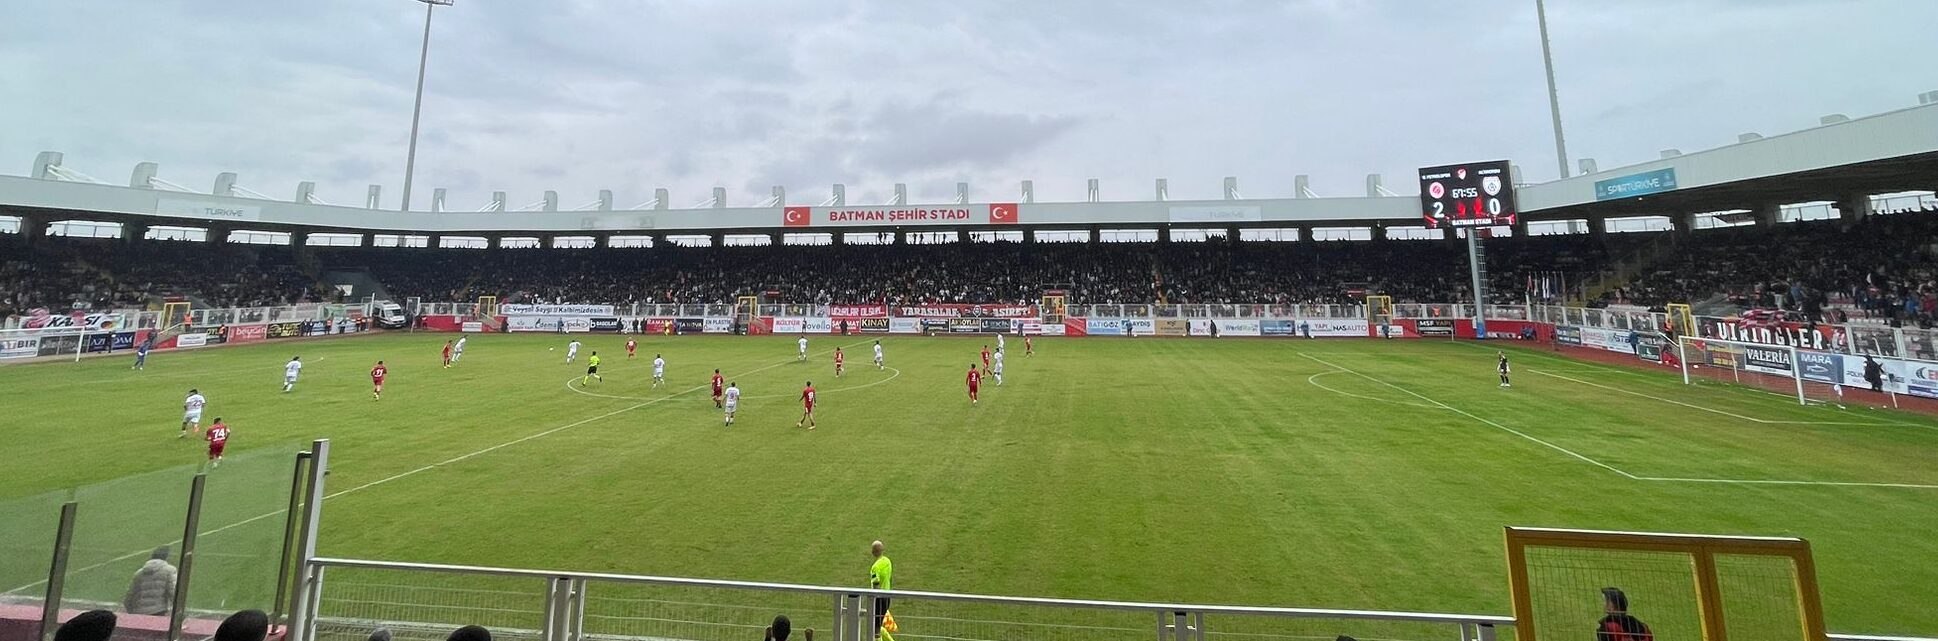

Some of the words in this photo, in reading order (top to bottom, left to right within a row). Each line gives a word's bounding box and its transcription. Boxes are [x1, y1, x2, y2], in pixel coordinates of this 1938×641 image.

[1452, 188, 1478, 199] 67:55
[1433, 202, 1445, 219] 2
[1489, 198, 1501, 215] 0
[829, 211, 885, 221] BATMAN
[888, 208, 927, 222] ŞEHİR
[930, 209, 970, 220] STADI
[862, 319, 888, 327] KINAY
[1746, 349, 1790, 364] VALERİA
[1800, 354, 1832, 365] MARA
[212, 428, 226, 439] 74
